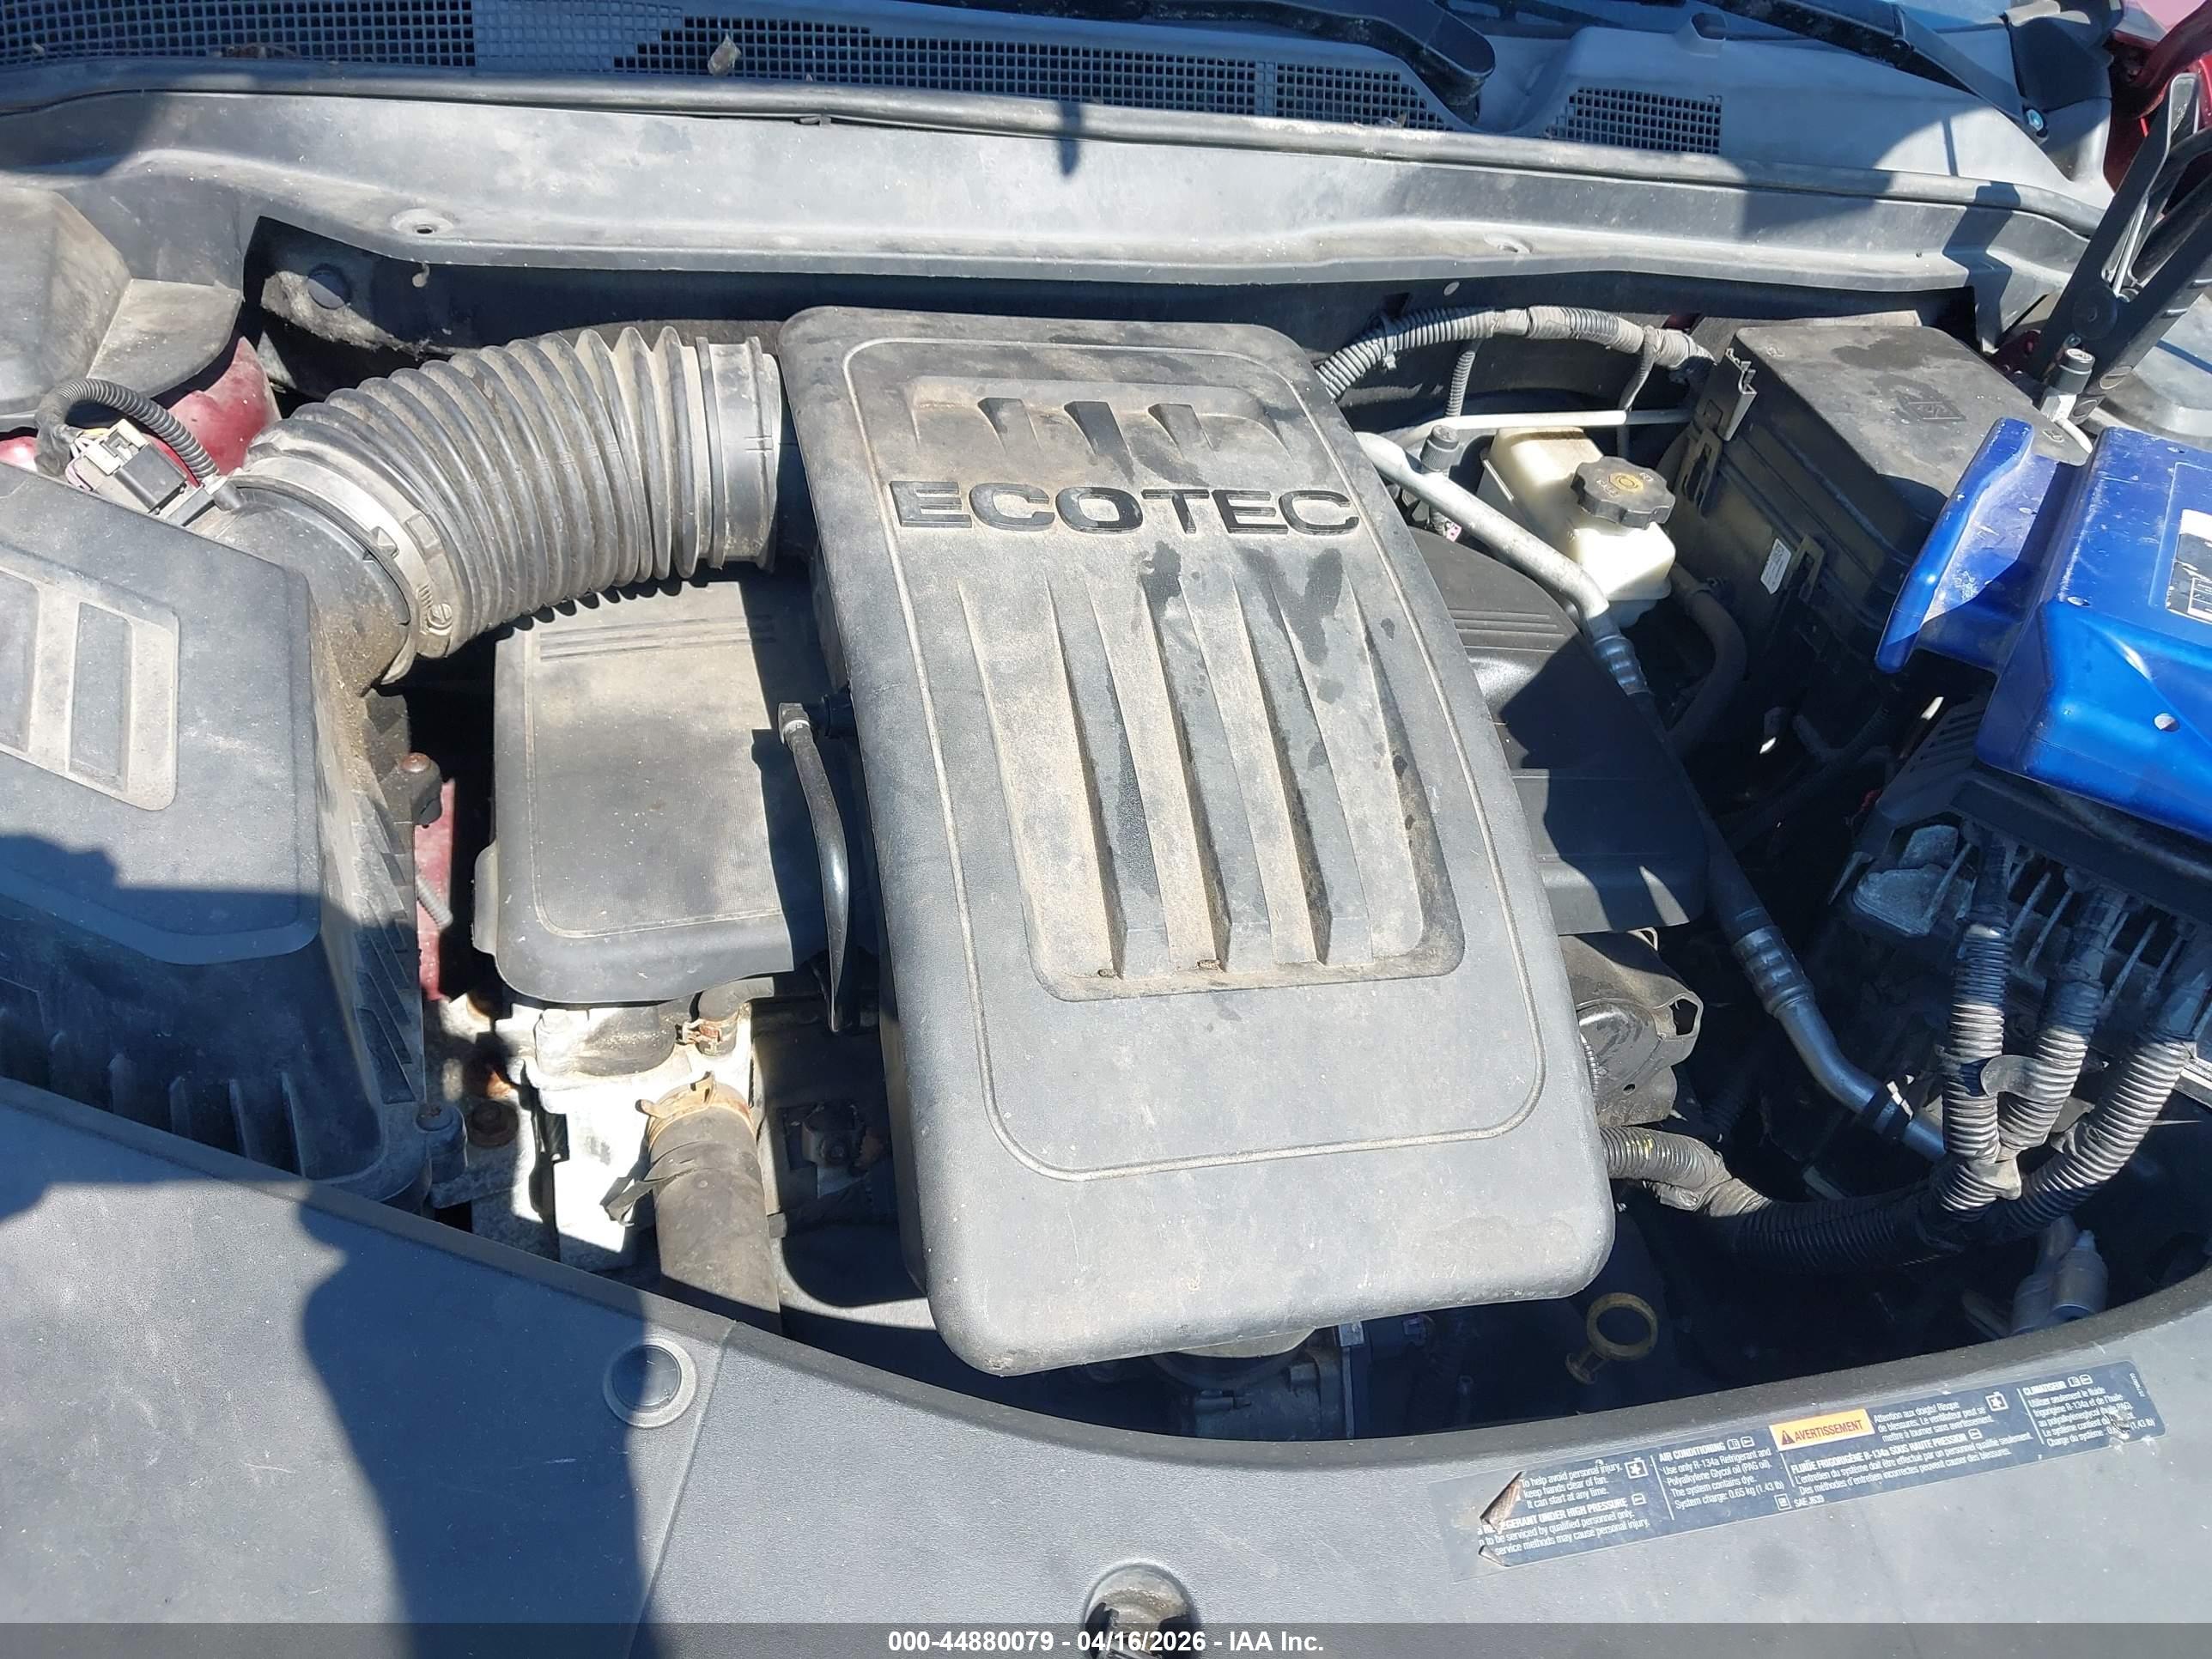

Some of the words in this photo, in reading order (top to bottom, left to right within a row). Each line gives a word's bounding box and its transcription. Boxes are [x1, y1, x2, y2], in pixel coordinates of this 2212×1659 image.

[890, 481, 1359, 536] ECOTEC
[2051, 1392, 2081, 1402] seulement
[2067, 1401, 2089, 1410] R-134a
[1874, 1412, 1901, 1422] Attention
[1938, 1402, 1959, 1413] Risque
[1929, 1412, 1961, 1422] ventilateur
[1963, 1408, 1977, 1418] peut
[1795, 1420, 1863, 1440] AVERTISSEMENT
[1882, 1432, 1903, 1442] mettre
[1911, 1427, 1931, 1437] tourner
[2047, 1437, 2069, 1447] Charge
[2130, 1421, 2146, 1431] (1.43
[1659, 1452, 1673, 1462] AIR
[1674, 1443, 1725, 1459] CONDITIONING
[1864, 1449, 1890, 1459] R-134a
[1890, 1445, 1909, 1455] SOUS
[1910, 1441, 1932, 1450] HAUTE
[1933, 1434, 1967, 1446] PRESSION
[1663, 1465, 1677, 1474] Use
[1678, 1463, 1692, 1473] only
[1693, 1458, 1719, 1468] R-134a
[1720, 1451, 1757, 1465] Refrigerant
[1758, 1448, 1771, 1456] and
[1795, 1472, 1829, 1484] L'entretien
[1923, 1452, 1934, 1461] par
[1945, 1443, 1976, 1456] personnel
[1521, 1479, 1529, 1487] To
[1530, 1476, 1547, 1486] help
[1548, 1473, 1567, 1482] avoid
[1569, 1467, 1600, 1480] personal
[1600, 1463, 1622, 1474] injury.
[1668, 1472, 1710, 1486] Polyalkylene
[1711, 1468, 1731, 1479] Glycol
[1732, 1465, 1741, 1474] oil
[1742, 1463, 1759, 1473] (PAG
[1799, 1486, 1813, 1494] Des
[1814, 1480, 1846, 1492] méthodes
[1847, 1473, 1882, 1485] d'entretien
[1883, 1466, 1918, 1478] incorrectes
[1919, 1461, 1945, 1473] peuvent
[1946, 1457, 1966, 1466] causer
[1967, 1453, 1979, 1462] des
[1524, 1488, 1541, 1498] keep
[1543, 1484, 1565, 1493] hands
[1566, 1480, 1584, 1489] clear
[1595, 1475, 1608, 1484] fan.
[1549, 1494, 1565, 1504] start
[1576, 1492, 1589, 1500] any
[1590, 1487, 1608, 1496] time.
[1672, 1487, 1685, 1497] The
[1686, 1484, 1711, 1495] system
[1712, 1478, 1741, 1489] contains
[1741, 1475, 1757, 1485] dye.
[1675, 1498, 1702, 1510] System
[1703, 1492, 1728, 1504] charge:
[1729, 1489, 1745, 1498] 0.65
[1746, 1487, 1755, 1497] kg
[1756, 1484, 1774, 1494] (1.43
[1775, 1482, 1784, 1491] lb)
[1538, 1510, 1565, 1522] UNDER
[1566, 1506, 1586, 1516] HIGH
[1587, 1498, 1628, 1513] PRESSURE
[1794, 1498, 1808, 1506] SAE
[1808, 1495, 1824, 1504] J639
[1496, 1534, 1504, 1542] be
[1506, 1528, 1537, 1540] serviced
[1538, 1527, 1548, 1535] by
[1549, 1521, 1581, 1534] qualified
[1581, 1514, 1616, 1527] personnel
[1496, 1544, 1522, 1554] service
[1523, 1537, 1554, 1549] methods
[1557, 1535, 1572, 1544] may
[1573, 1530, 1595, 1540] cause
[1596, 1523, 1627, 1536] personal
[1628, 1519, 1650, 1530] injury.
